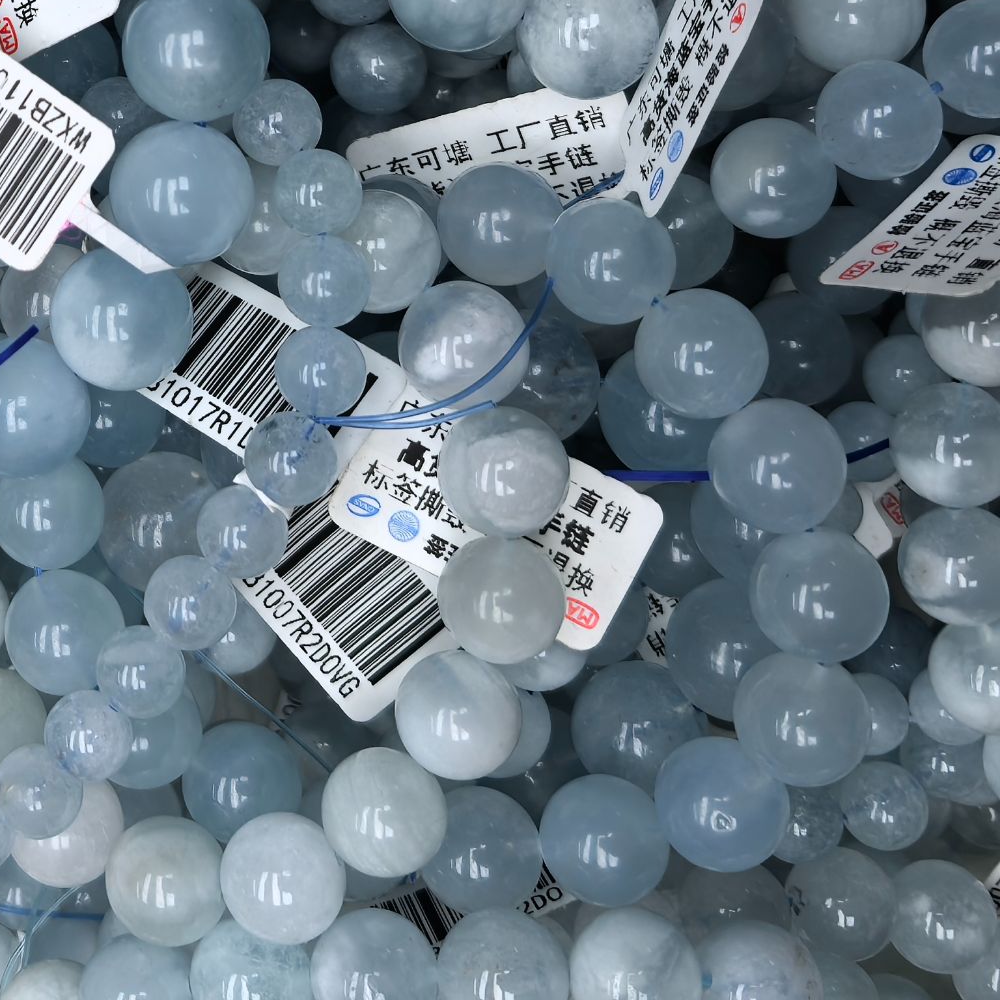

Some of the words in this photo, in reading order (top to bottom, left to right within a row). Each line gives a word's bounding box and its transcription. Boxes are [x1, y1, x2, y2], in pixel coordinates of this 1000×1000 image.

[627, 39, 675, 145] 广东可塘
[359, 141, 472, 187] 广东可塘
[487, 106, 605, 154] 工厂直销
[522, 144, 598, 179] 手链
